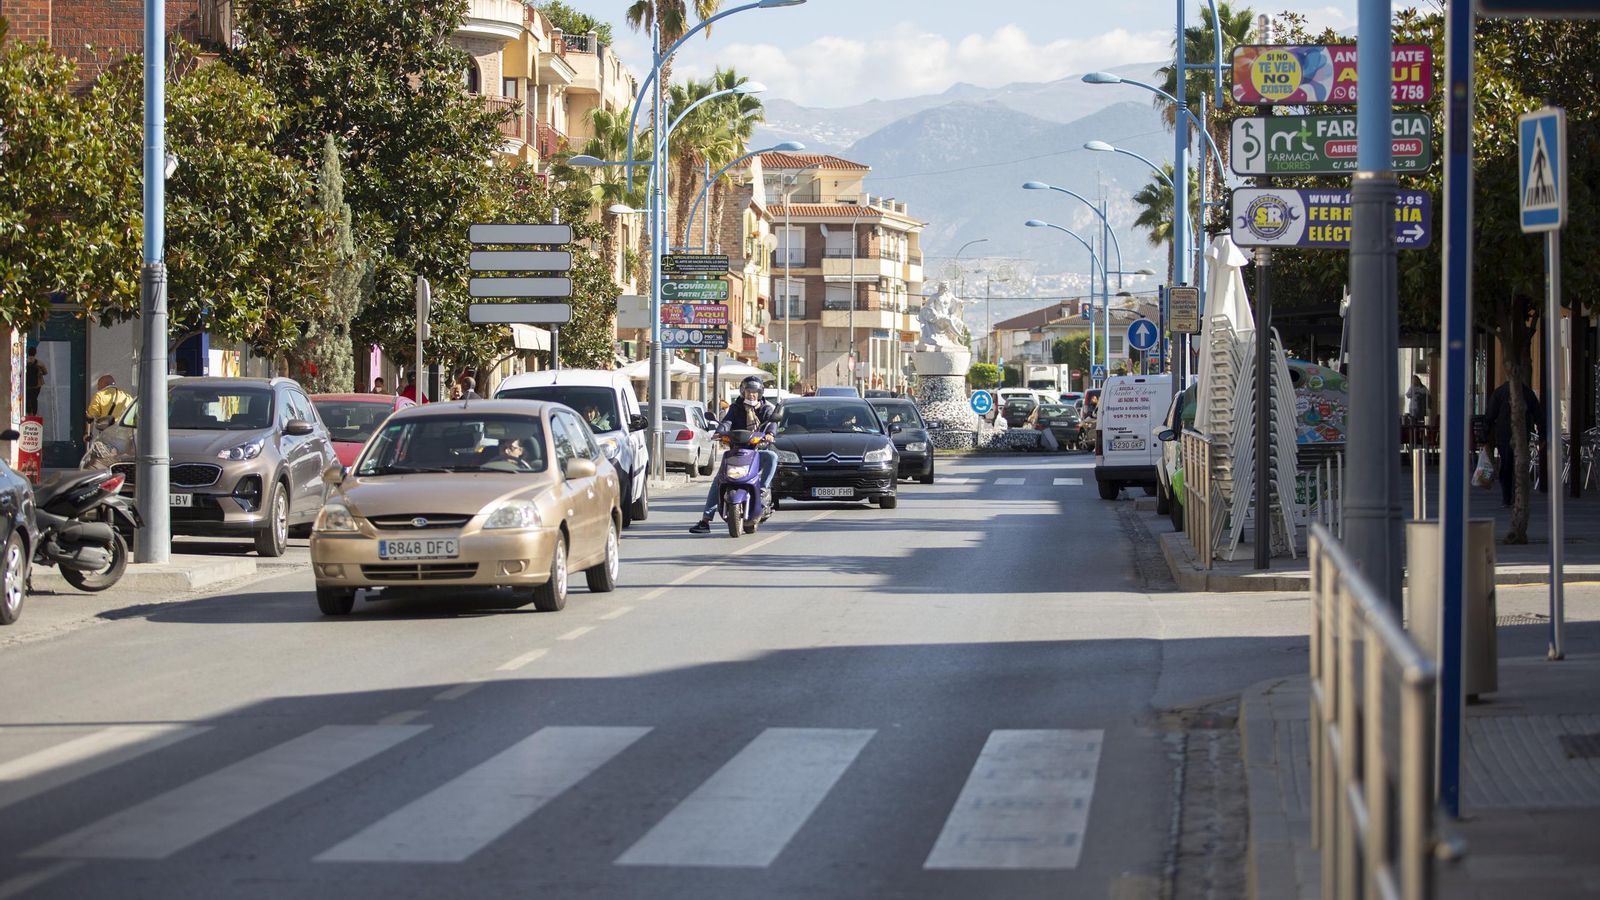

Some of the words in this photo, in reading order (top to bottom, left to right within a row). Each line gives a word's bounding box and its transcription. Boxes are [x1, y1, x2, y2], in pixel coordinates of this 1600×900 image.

[1266, 53, 1274, 61] SI
[1276, 53, 1288, 61] NO
[1259, 62, 1271, 73] TE
[1274, 62, 1296, 73] VEN
[1264, 74, 1290, 84] NO
[1261, 85, 1293, 94] EXISTES
[1401, 85, 1424, 100] 758
[1391, 144, 1417, 152] ORAS
[1267, 152, 1319, 162] FARMACIA
[1275, 161, 1311, 170] TORRES
[1405, 160, 1416, 168] 28
[1309, 224, 1352, 241] ELÉCT
[170, 495, 188, 505] LBV
[388, 542, 422, 555] 6848
[427, 541, 454, 554] DFC
